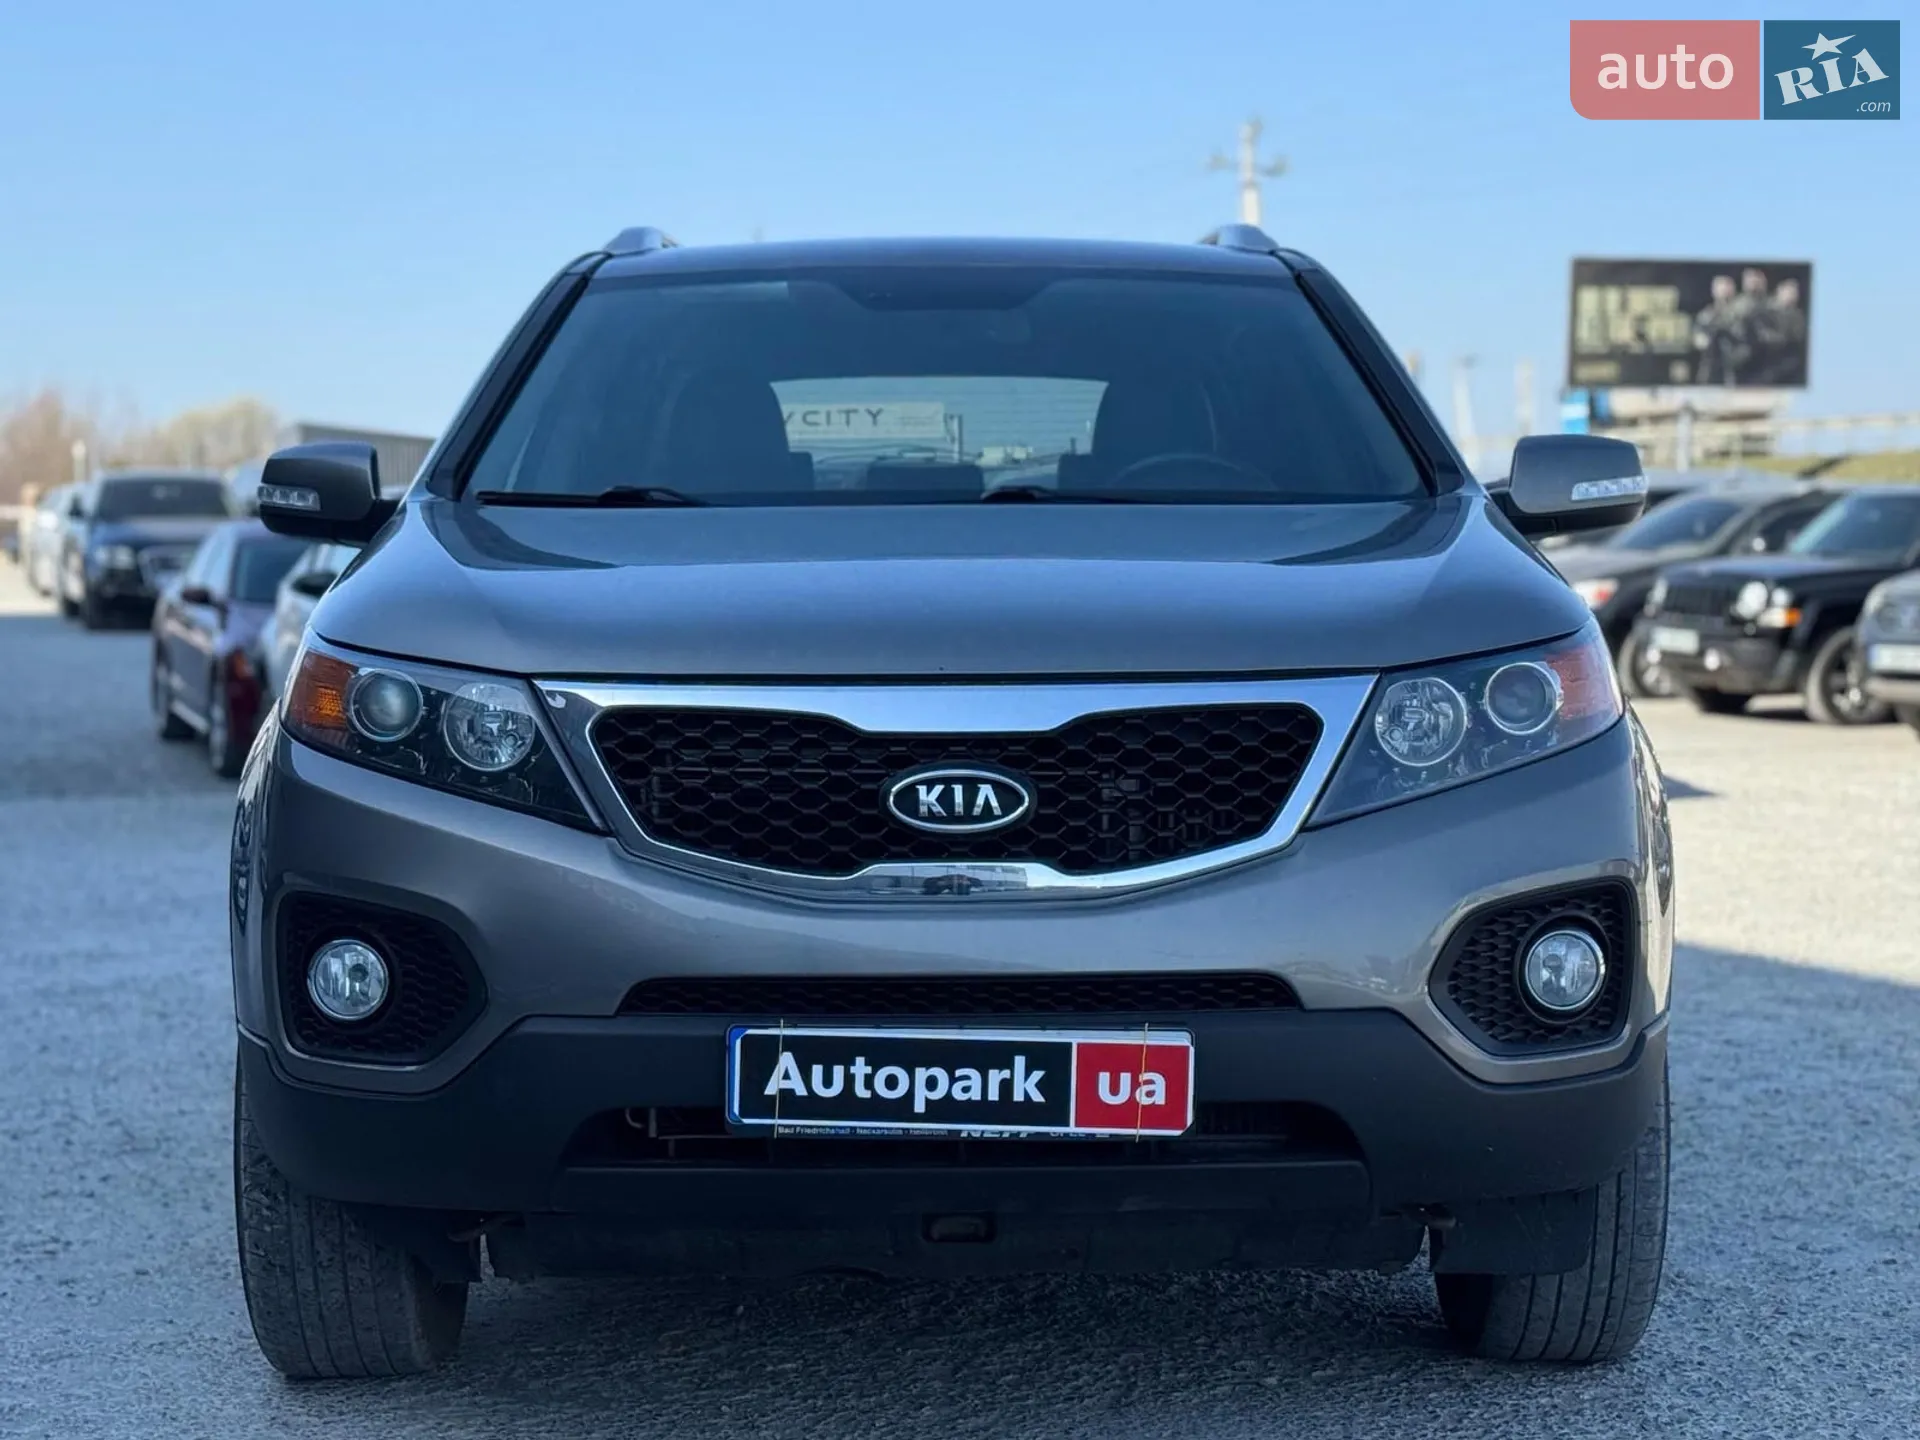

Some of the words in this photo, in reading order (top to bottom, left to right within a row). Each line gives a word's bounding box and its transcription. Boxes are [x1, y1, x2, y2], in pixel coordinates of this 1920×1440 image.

[915, 784, 1002, 817] KIA
[764, 1051, 1046, 1113] Autopark
[1098, 1070, 1167, 1106] ua
